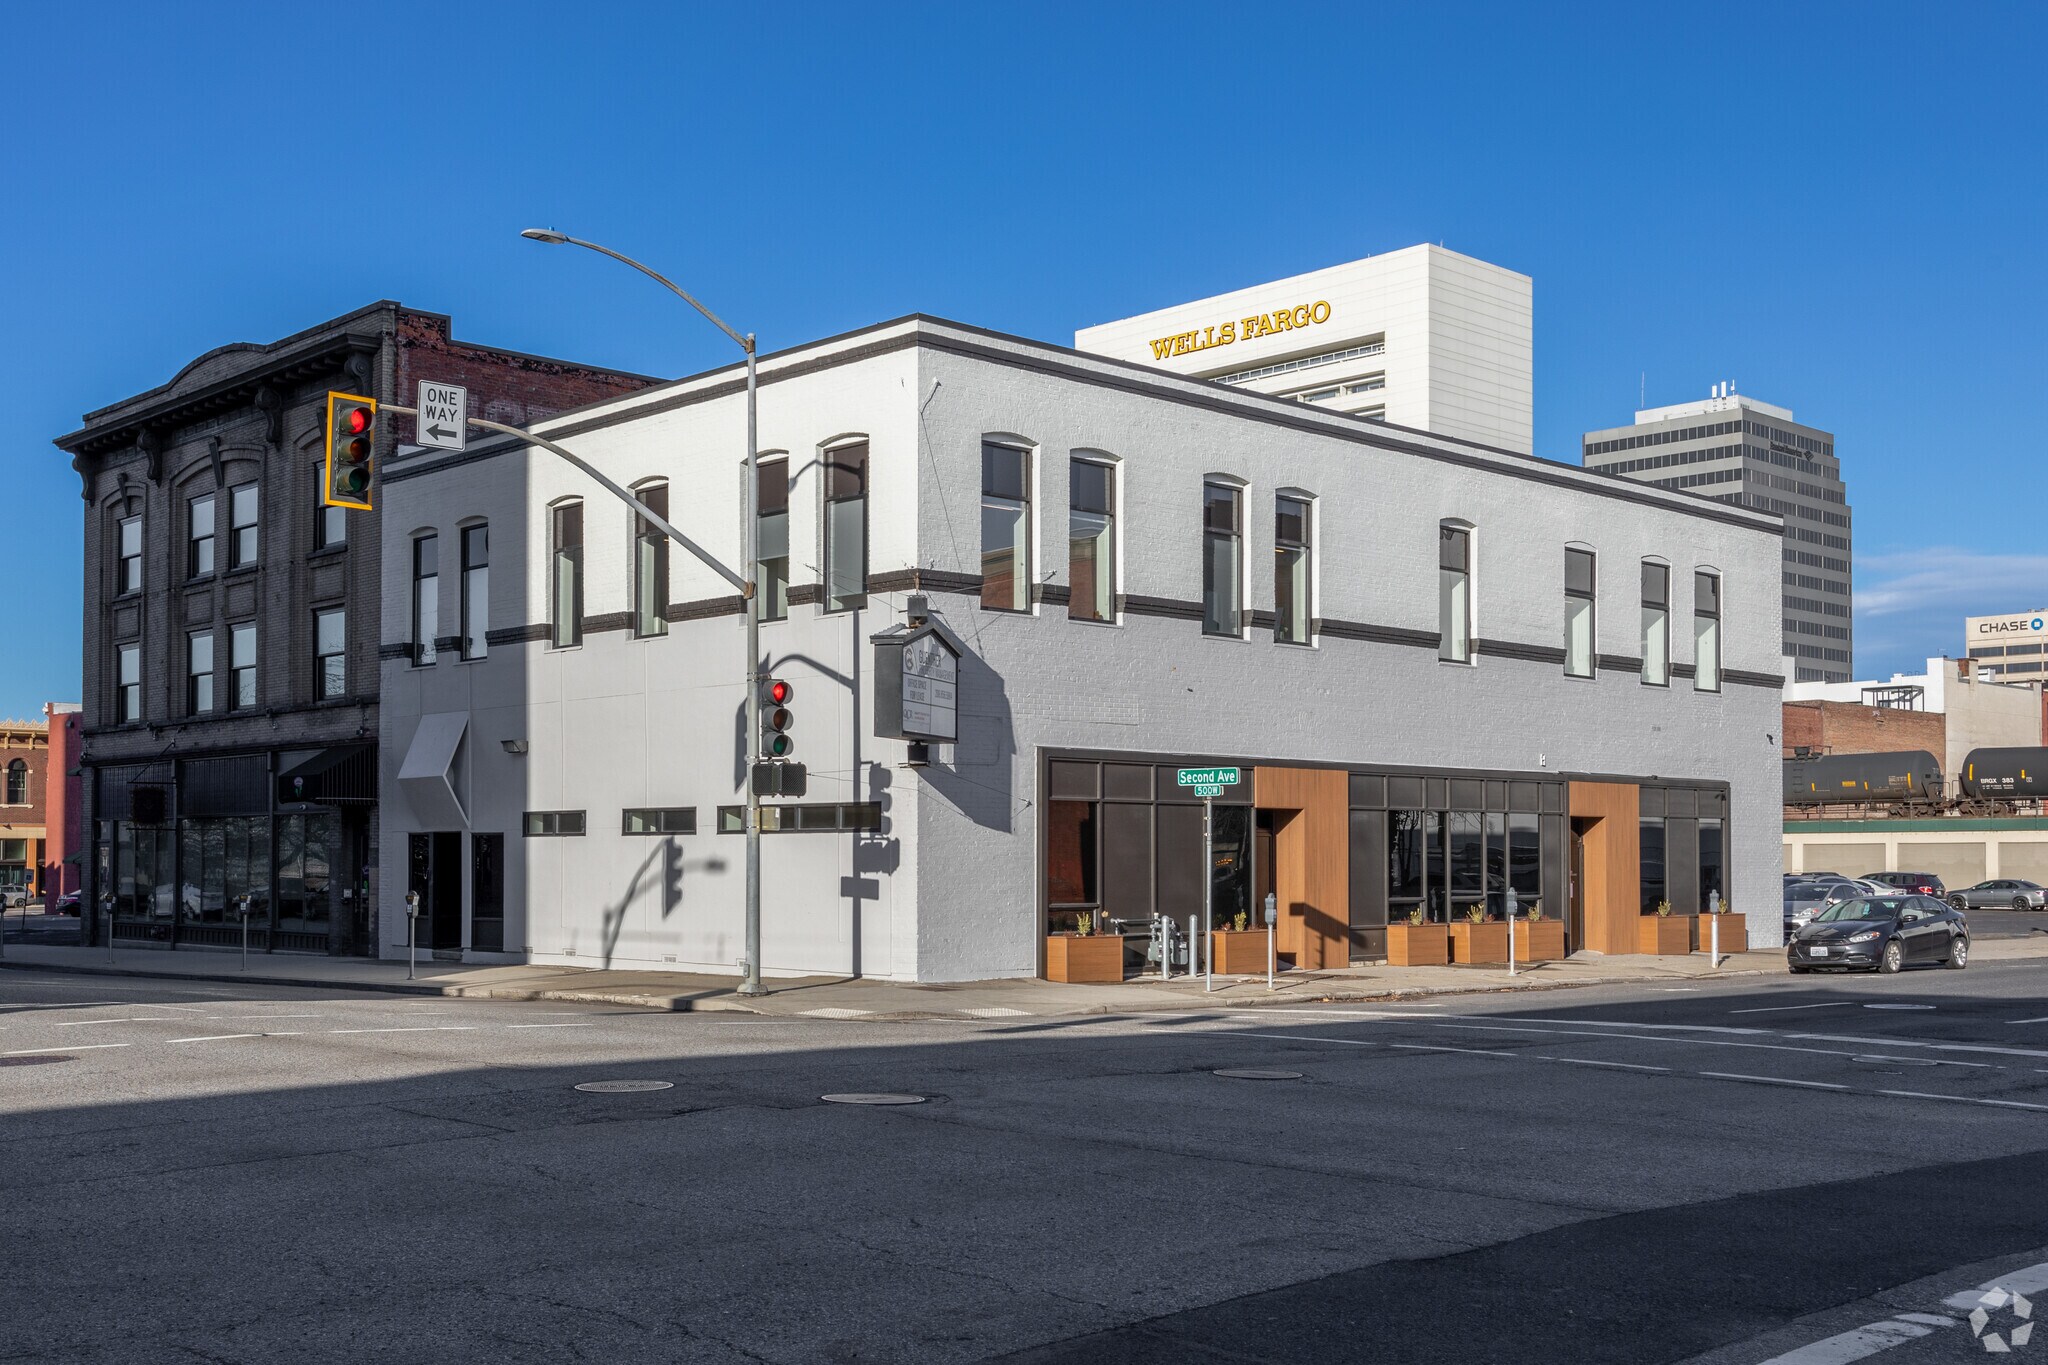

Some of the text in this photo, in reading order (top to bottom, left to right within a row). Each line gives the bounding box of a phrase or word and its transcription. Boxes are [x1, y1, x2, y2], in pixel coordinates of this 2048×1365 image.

[1149, 300, 1332, 360] WELLS FARGO
[427, 388, 457, 406] ONE
[425, 404, 458, 423] WAY
[1980, 620, 2029, 634] CHASE
[1180, 770, 1236, 783] Second Ave
[1197, 786, 1219, 795] 500W
